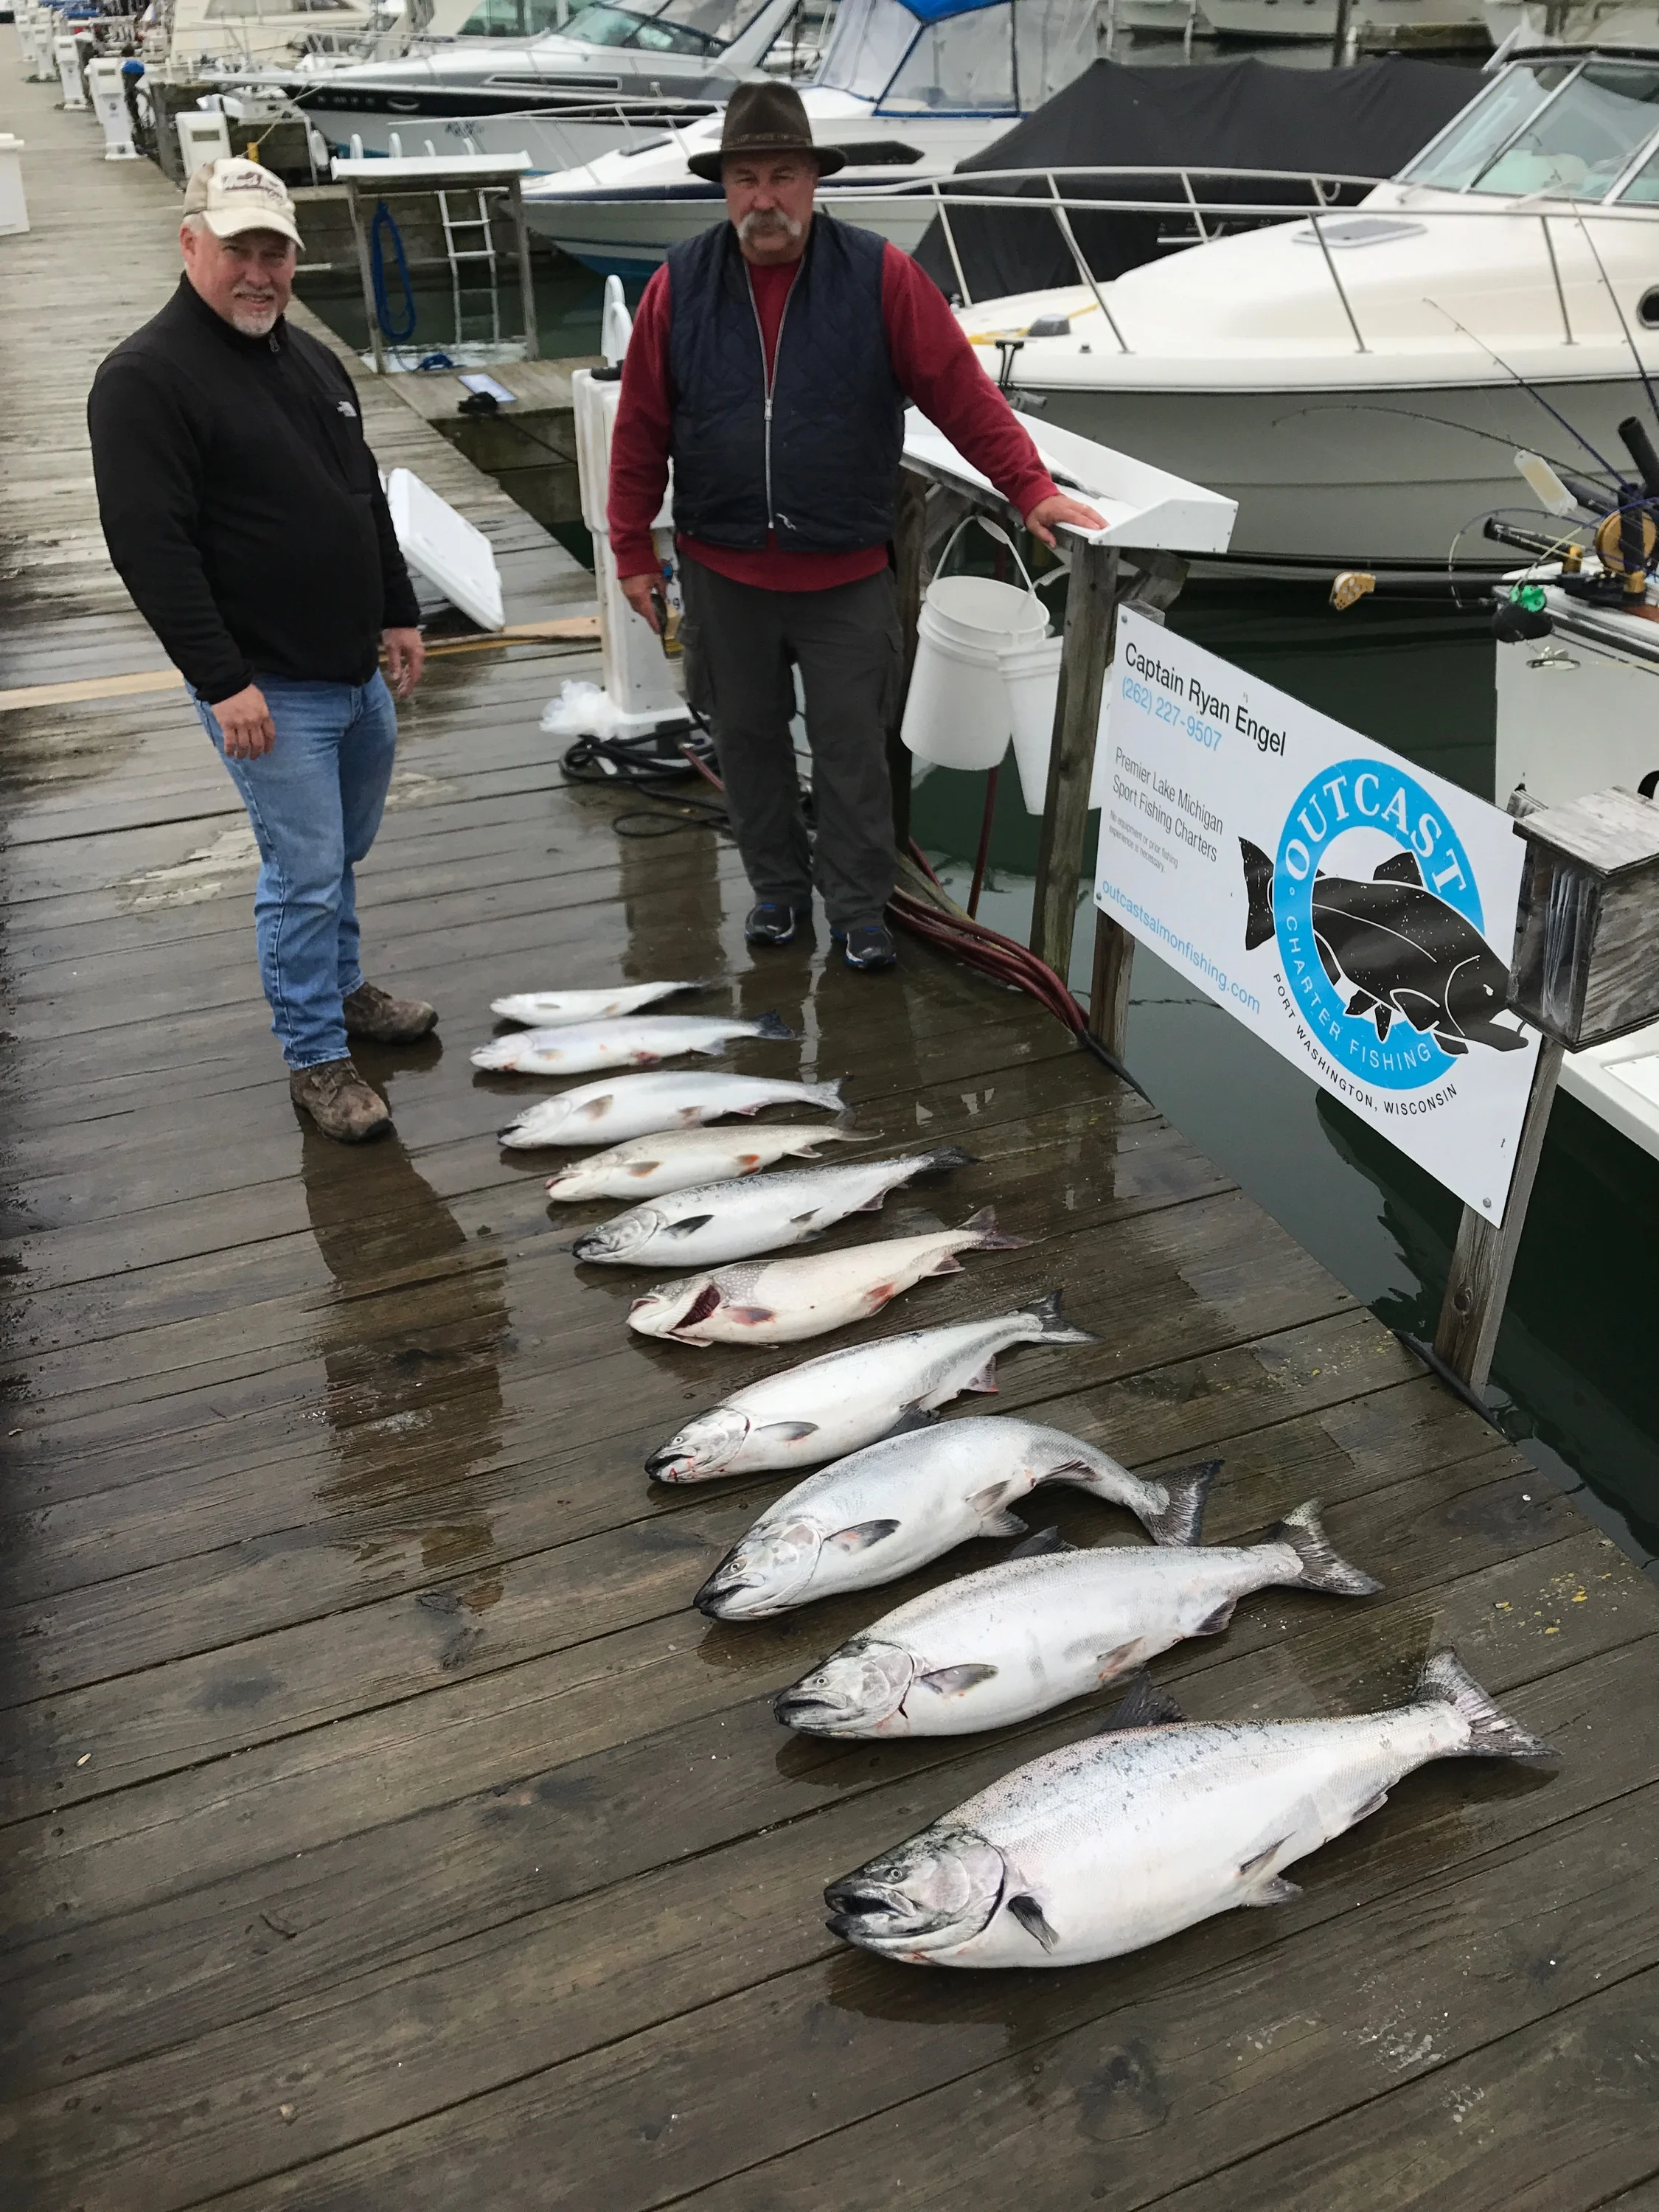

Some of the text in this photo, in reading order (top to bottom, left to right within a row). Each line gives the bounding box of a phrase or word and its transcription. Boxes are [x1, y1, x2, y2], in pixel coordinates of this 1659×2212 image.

[1121, 676, 1222, 751] (262) 227-9507
[1125, 642, 1286, 757] Captain Ryan Engel
[1109, 825, 1134, 849] experience
[1110, 810, 1117, 822] No
[1117, 818, 1143, 841] equipment
[1161, 847, 1178, 869] fishing
[1113, 774, 1217, 862] Sport Fishing Charters
[1116, 746, 1223, 835] Premier Lake Michigan
[1285, 773, 1467, 894] OUTCAST
[1102, 880, 1260, 1015] outcastsalmonfishing.com
[1286, 916, 1432, 1071] CHARTER FISHING
[1273, 973, 1457, 1116] PORT WASHINGTON, WISCONSIN
